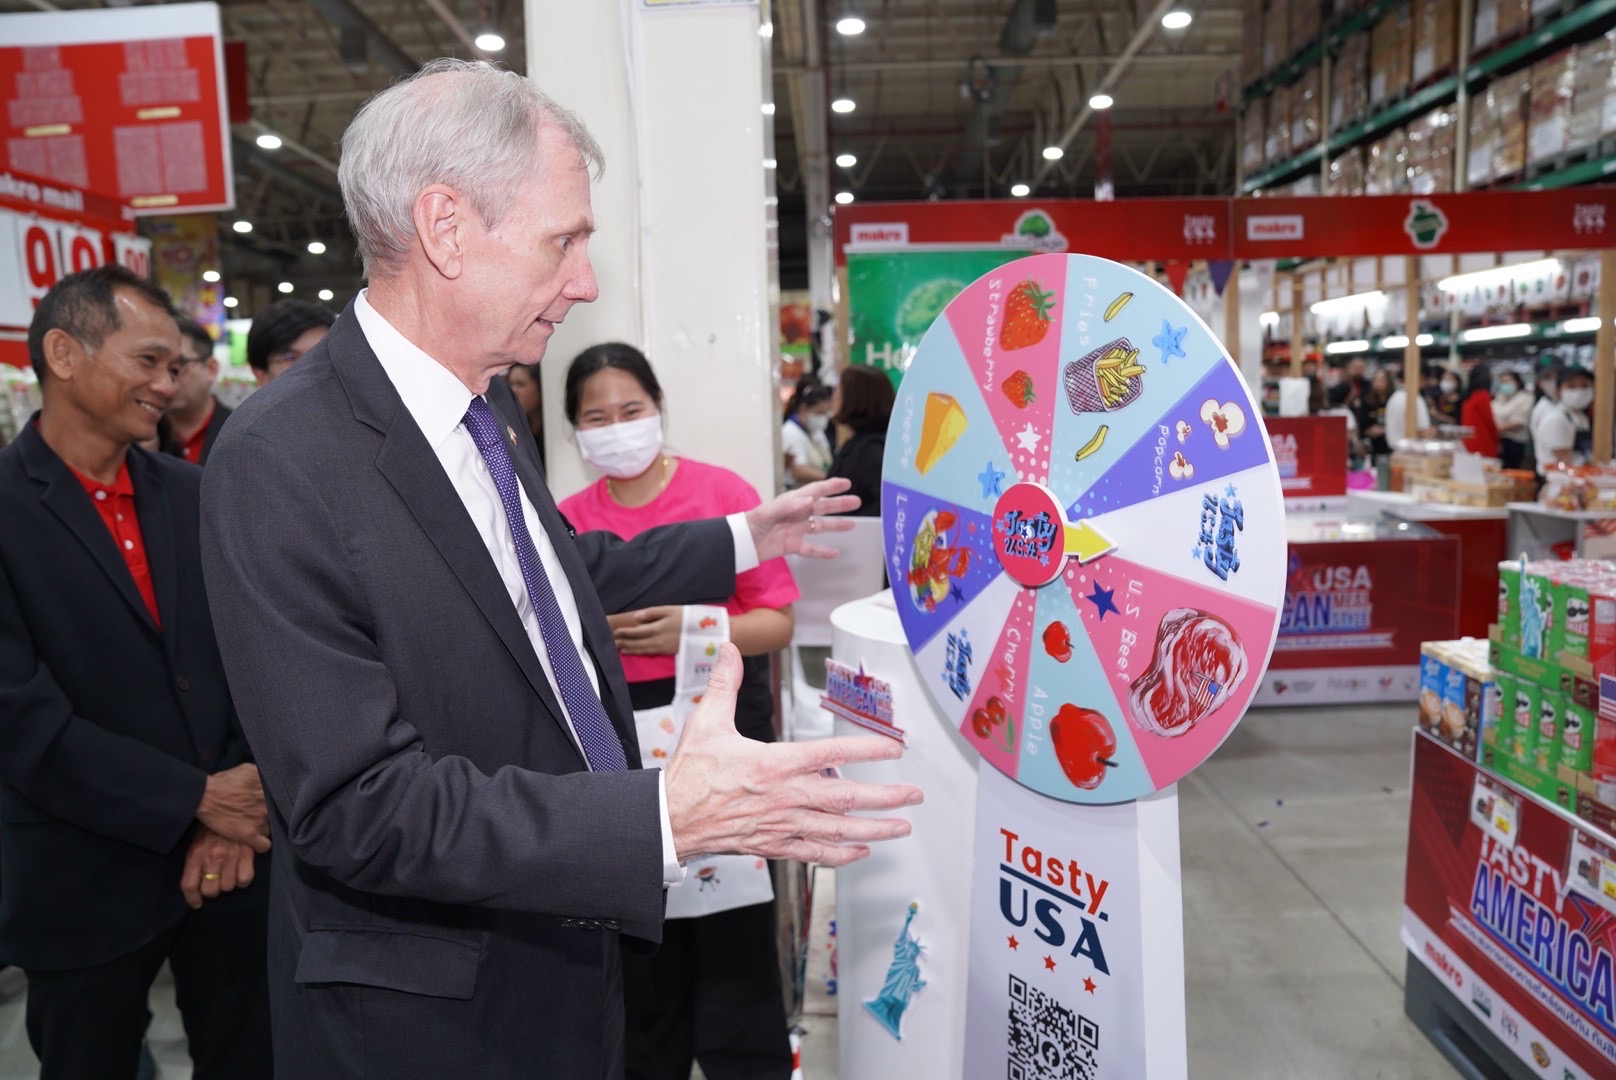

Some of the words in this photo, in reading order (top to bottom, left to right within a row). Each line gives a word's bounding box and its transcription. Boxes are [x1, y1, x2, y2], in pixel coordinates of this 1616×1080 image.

[982, 279, 1001, 392] Strawberry
[1077, 276, 1098, 346] Fries
[892, 492, 909, 582] Lobster
[1312, 565, 1373, 591] USA
[1004, 626, 1021, 703] Cherry
[1117, 627, 1138, 682] Beef
[1027, 685, 1048, 756] Apple
[1000, 827, 1109, 916] Tasty
[1000, 877, 1111, 977] USA
[1424, 940, 1463, 989] makro
